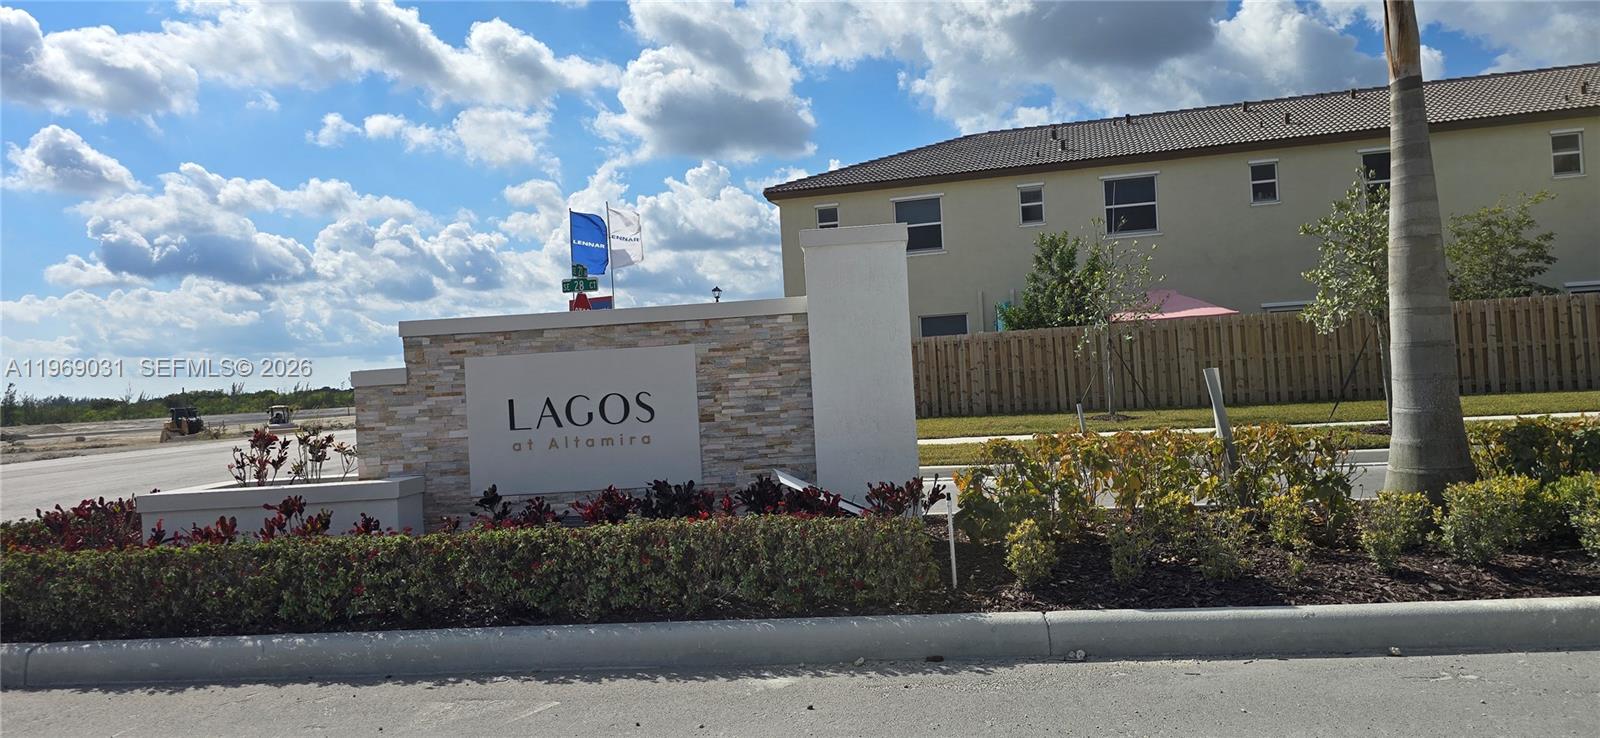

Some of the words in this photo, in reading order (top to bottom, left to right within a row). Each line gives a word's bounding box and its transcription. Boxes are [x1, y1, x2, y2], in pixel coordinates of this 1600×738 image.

[572, 239, 605, 249] LENNAR
[563, 283, 571, 291] SE
[574, 280, 585, 291] 28
[589, 281, 597, 289] CT
[508, 391, 655, 431] LAGOS
[512, 438, 534, 452] at
[548, 433, 652, 450] Altamira
